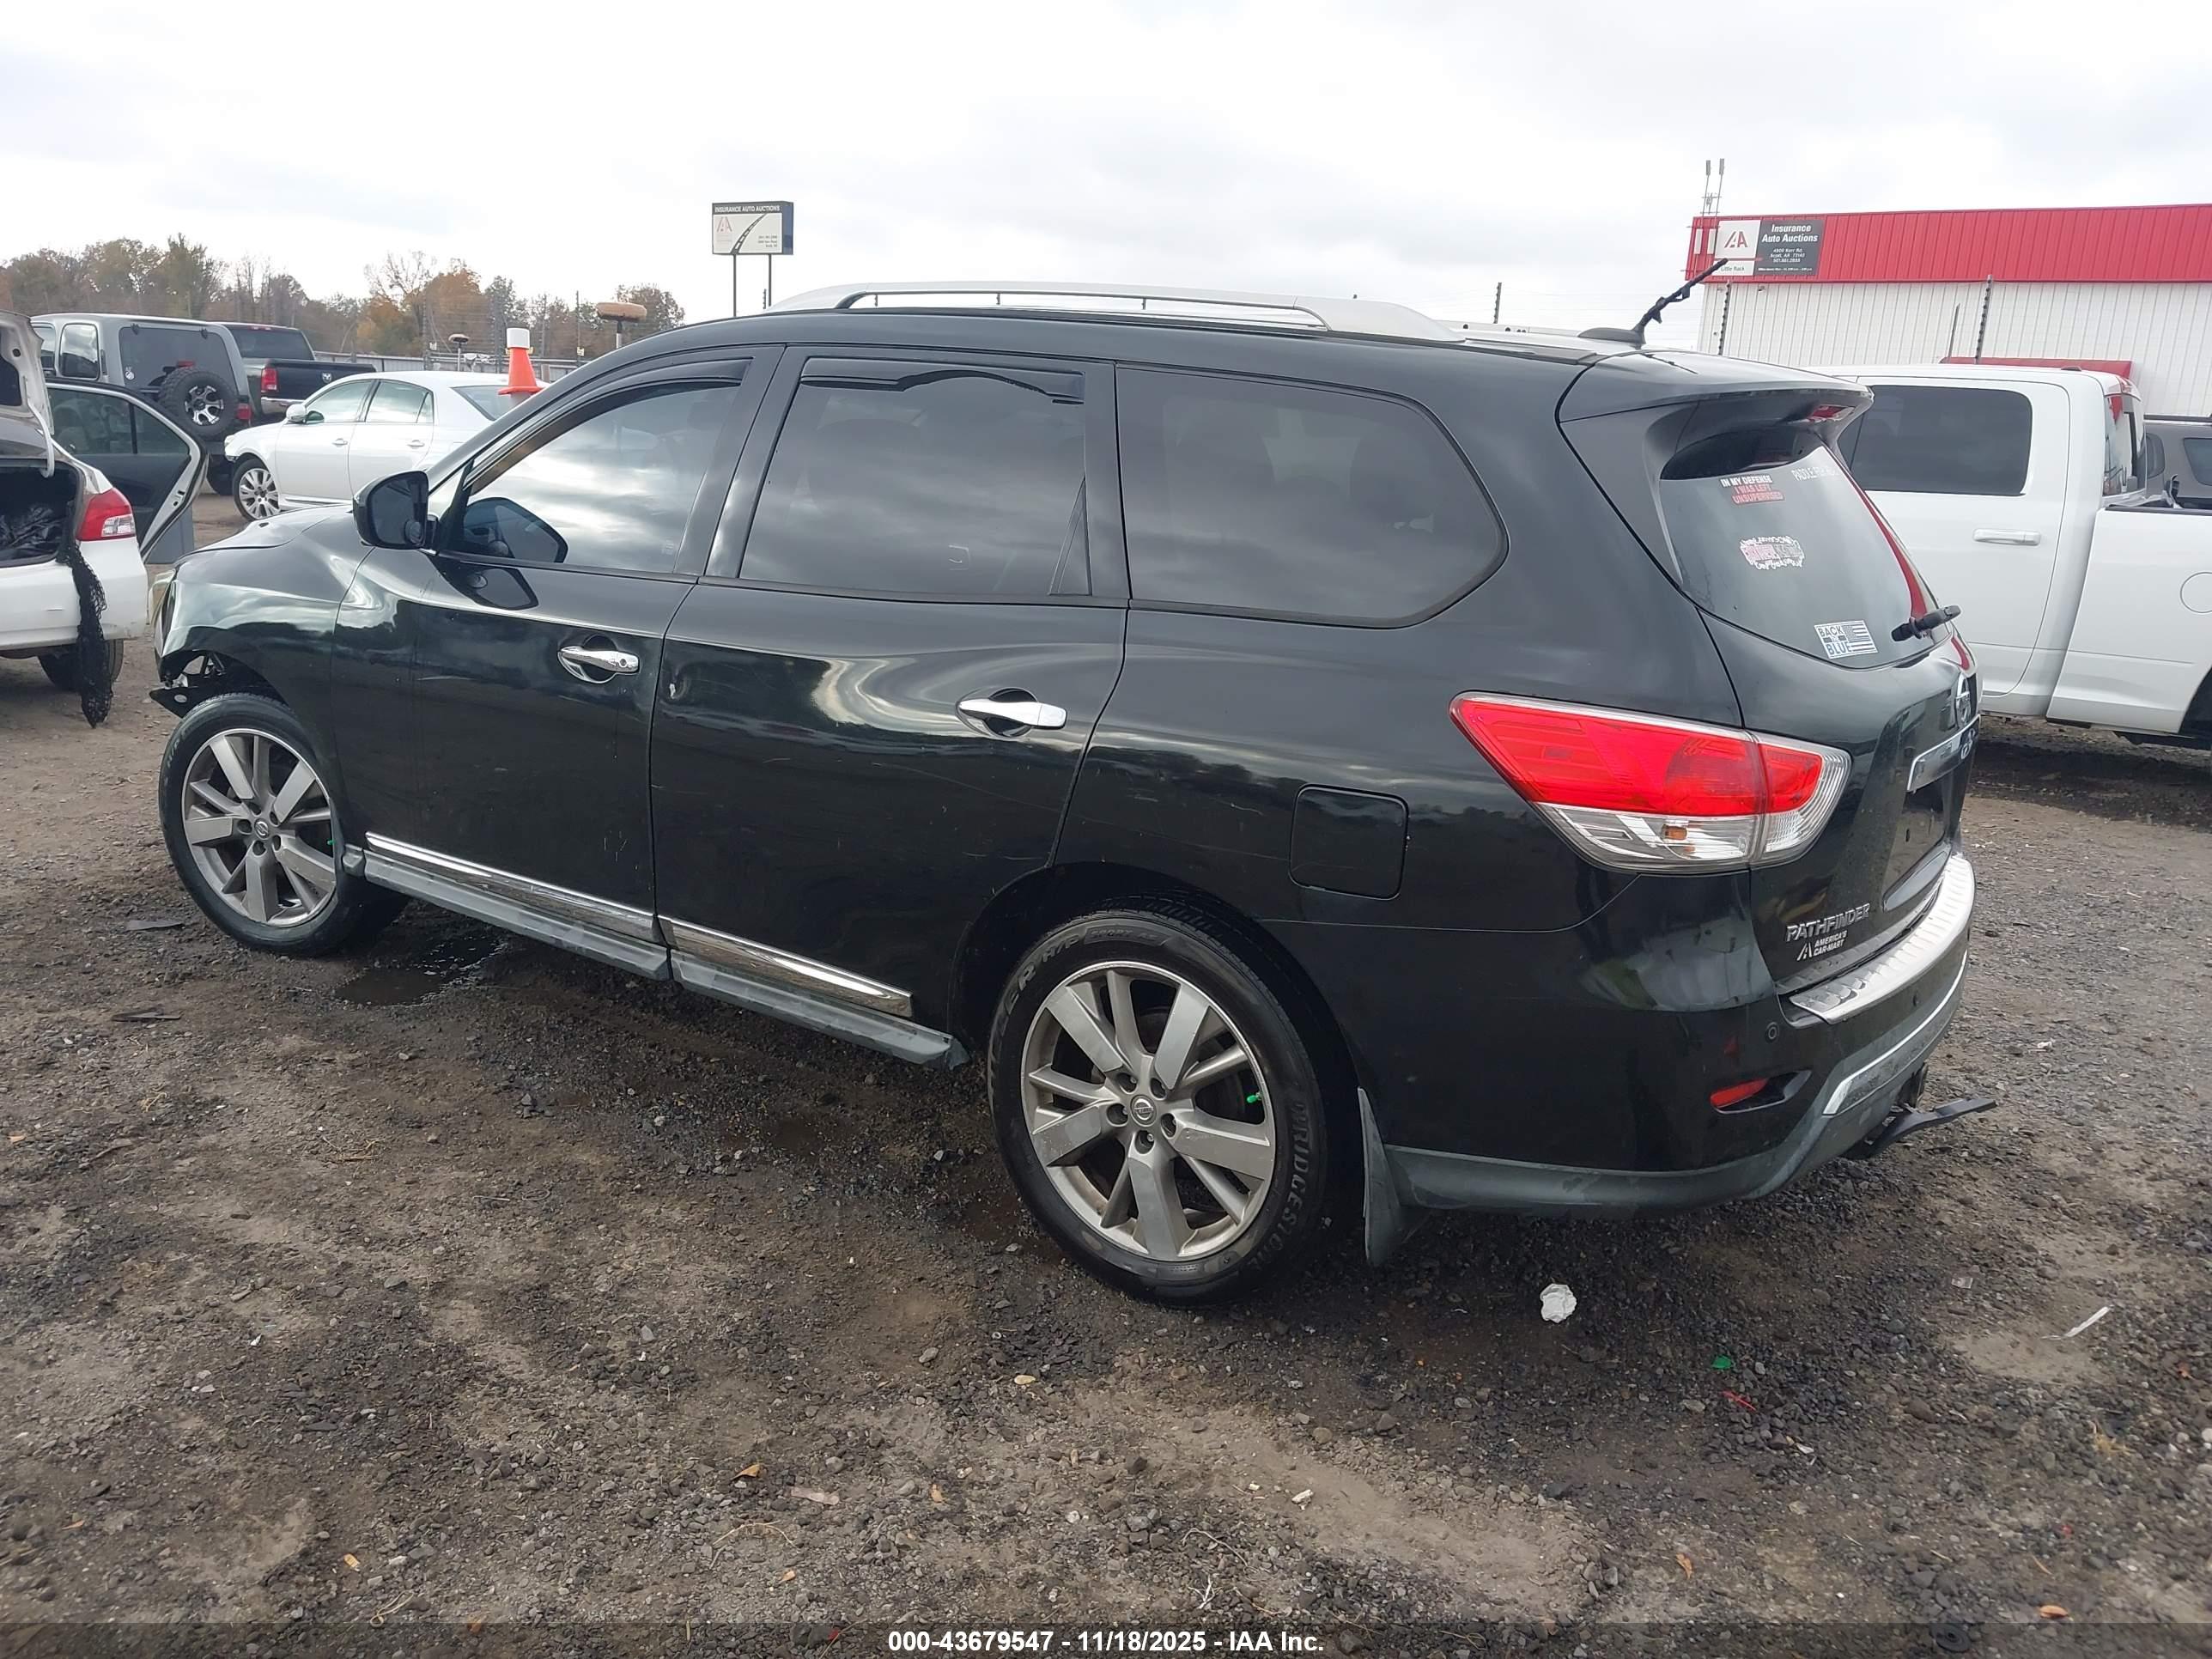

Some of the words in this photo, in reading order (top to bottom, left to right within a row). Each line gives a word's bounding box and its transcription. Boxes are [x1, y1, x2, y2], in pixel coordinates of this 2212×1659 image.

[1771, 224, 1812, 233] Insurance
[1761, 234, 1781, 243] Auto
[1782, 234, 1819, 242] Auctions
[1720, 478, 1730, 487] IN
[1729, 477, 1742, 486] MY
[1741, 475, 1773, 484] DEFENSE
[1740, 485, 1755, 494] WAS
[1754, 483, 1771, 492] LEFT
[1818, 625, 1844, 637] BACK
[1826, 641, 1853, 655] BLUE
[1786, 902, 1870, 942] PATHFINDER
[1091, 928, 1133, 939] SPORT
[1814, 930, 1848, 948] AMERICA'S
[1813, 939, 1844, 957] CAR-MART
